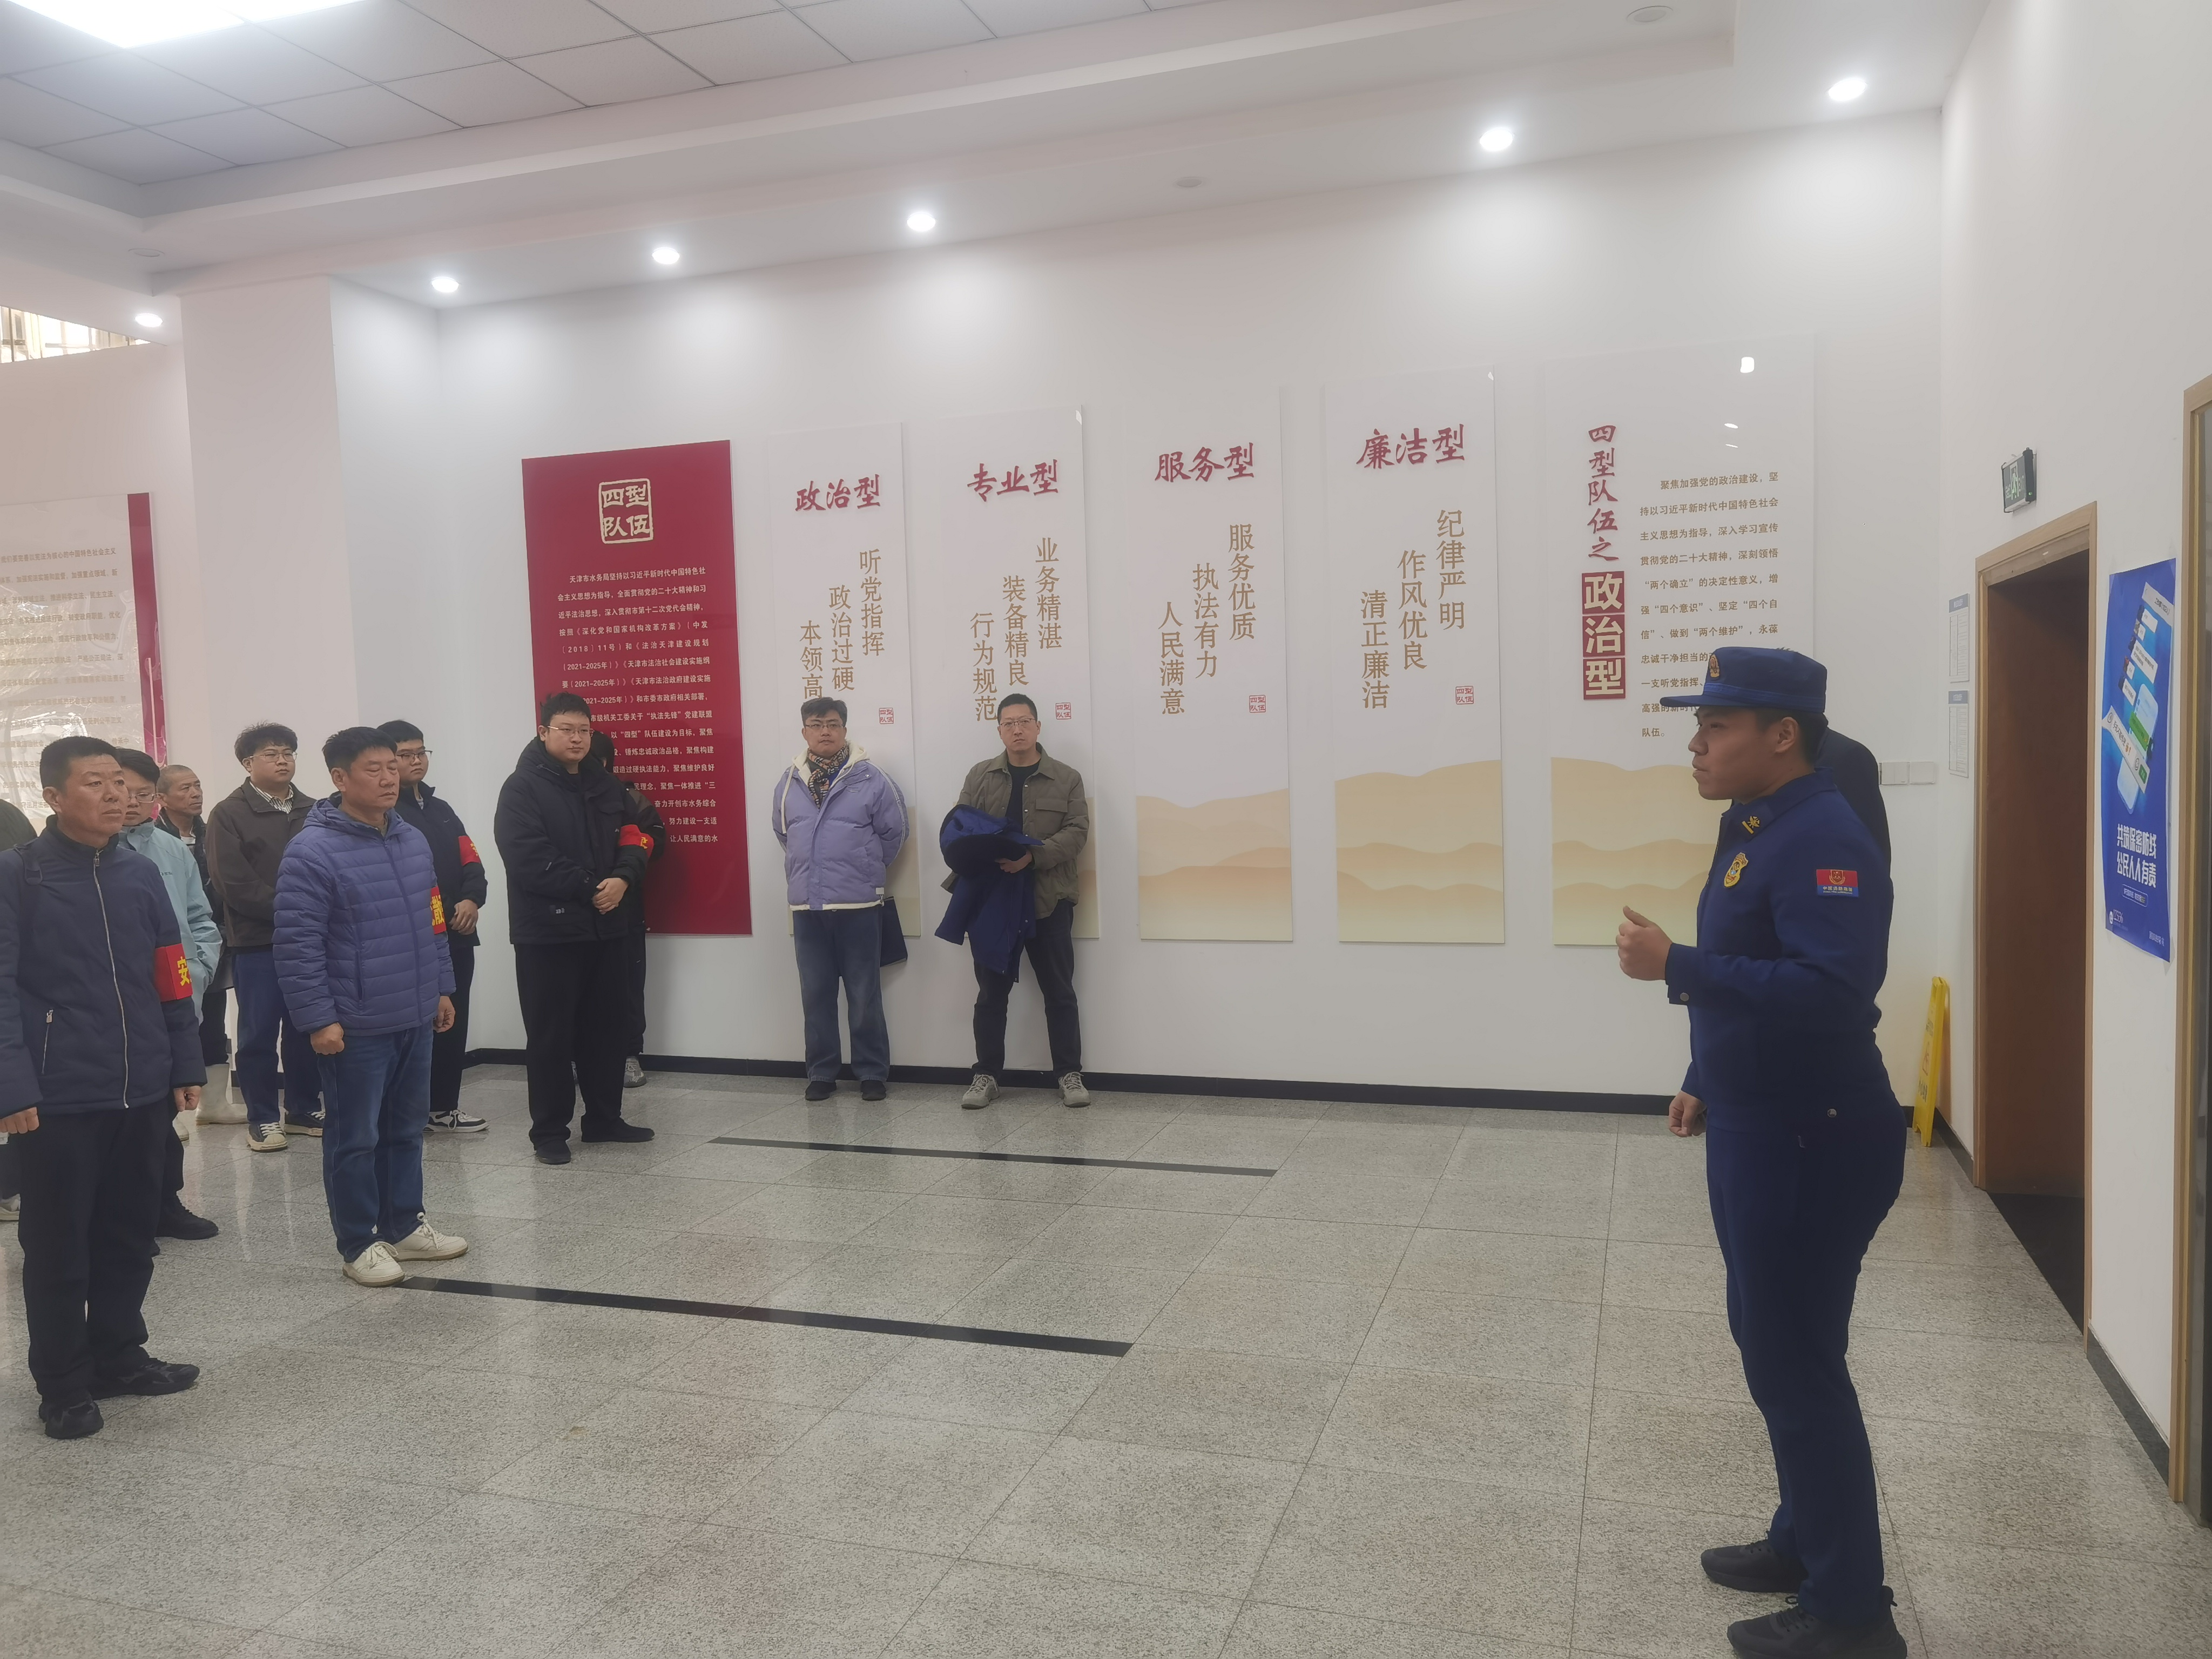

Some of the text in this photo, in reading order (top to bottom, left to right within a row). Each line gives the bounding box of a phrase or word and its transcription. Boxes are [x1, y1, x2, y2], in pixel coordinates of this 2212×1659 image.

[1155, 442, 1255, 482] 服务型
[1356, 423, 1466, 469] 廉洁型
[794, 474, 881, 511] 政治型
[967, 459, 1059, 502] 专业型
[1661, 471, 1778, 490] 聚焦加强党的政治建设，坚
[1640, 497, 1778, 516] 持以习近平新时代中国特色社会
[1640, 523, 1778, 541] 主义思想为指导，深入学习宣传
[570, 567, 706, 583] 天津市水务局坚持以习近平新时代中国特色社
[1436, 509, 1466, 630] 纪律严明
[1584, 425, 1623, 696] 四型队伍之 政治型
[1640, 548, 1778, 566] 贯彻党的二十大精神，深刻领悟
[557, 584, 706, 602] 会主义思想为指导，全面贯彻党的二十大精神和习
[859, 548, 885, 657] 听党指挥
[1035, 537, 1062, 650] 业务精湛
[1228, 523, 1256, 641] 服务优质
[558, 603, 704, 619] 近平法治思想，深入贯彻市第十二次党代会精神，
[1192, 563, 1220, 678] 执法有力
[1397, 550, 1427, 670] 作风优良
[828, 585, 855, 692] 政治过硬
[1002, 575, 1029, 687] 装备精良
[1360, 589, 1390, 709] 清正廉洁
[799, 620, 823, 699] 本领高
[970, 612, 998, 721] 行为规范
[1158, 601, 1185, 715] 人民满意
[1641, 652, 1712, 664] 忠诚干净担当的
[1642, 728, 1665, 738] 队伍。
[654, 799, 716, 808] 奋力开创市水务综合
[670, 834, 718, 842] 让人民满意的水
[2117, 824, 2156, 859] 共筑保密防线
[2117, 851, 2156, 888] 公民人人有责
